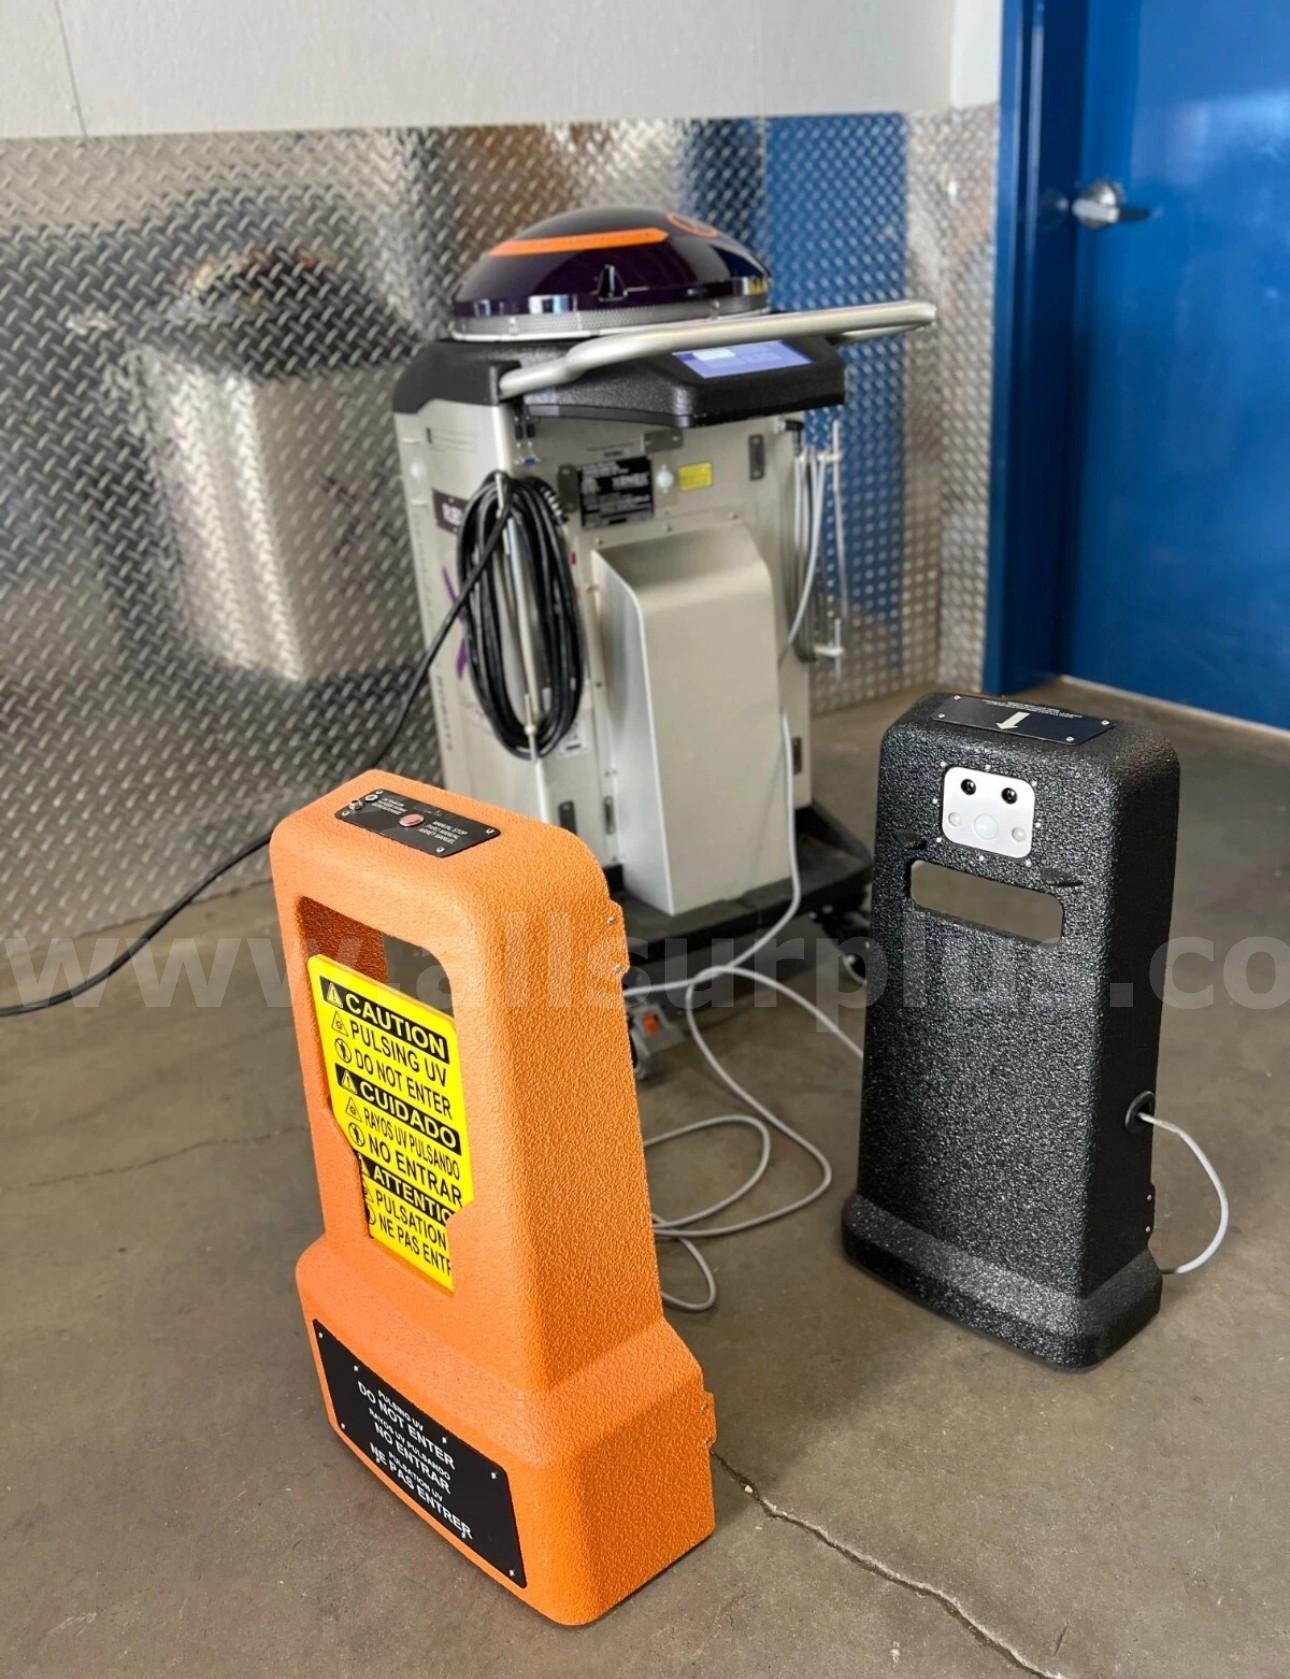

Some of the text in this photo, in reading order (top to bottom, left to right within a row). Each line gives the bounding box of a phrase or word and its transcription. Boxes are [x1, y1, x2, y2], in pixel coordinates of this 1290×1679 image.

[345, 992, 446, 1060] CAUTION
[350, 1019, 446, 1087] PULSING UV
[355, 1048, 453, 1121] DO NOT ENTER
[359, 1080, 457, 1149] CUIDADO
[364, 1107, 460, 1181] RAYOS UV PULSANDO
[368, 1133, 463, 1209] NO ENTRAR
[375, 1189, 447, 1252] PULSATION
[378, 1212, 396, 1239] NE
[397, 1226, 420, 1256] PAS
[357, 1380, 456, 1470] DO NOT ENTER
[374, 1421, 452, 1495] NO ENTRAR
[369, 1442, 473, 1540] NE PAS ENTRER
